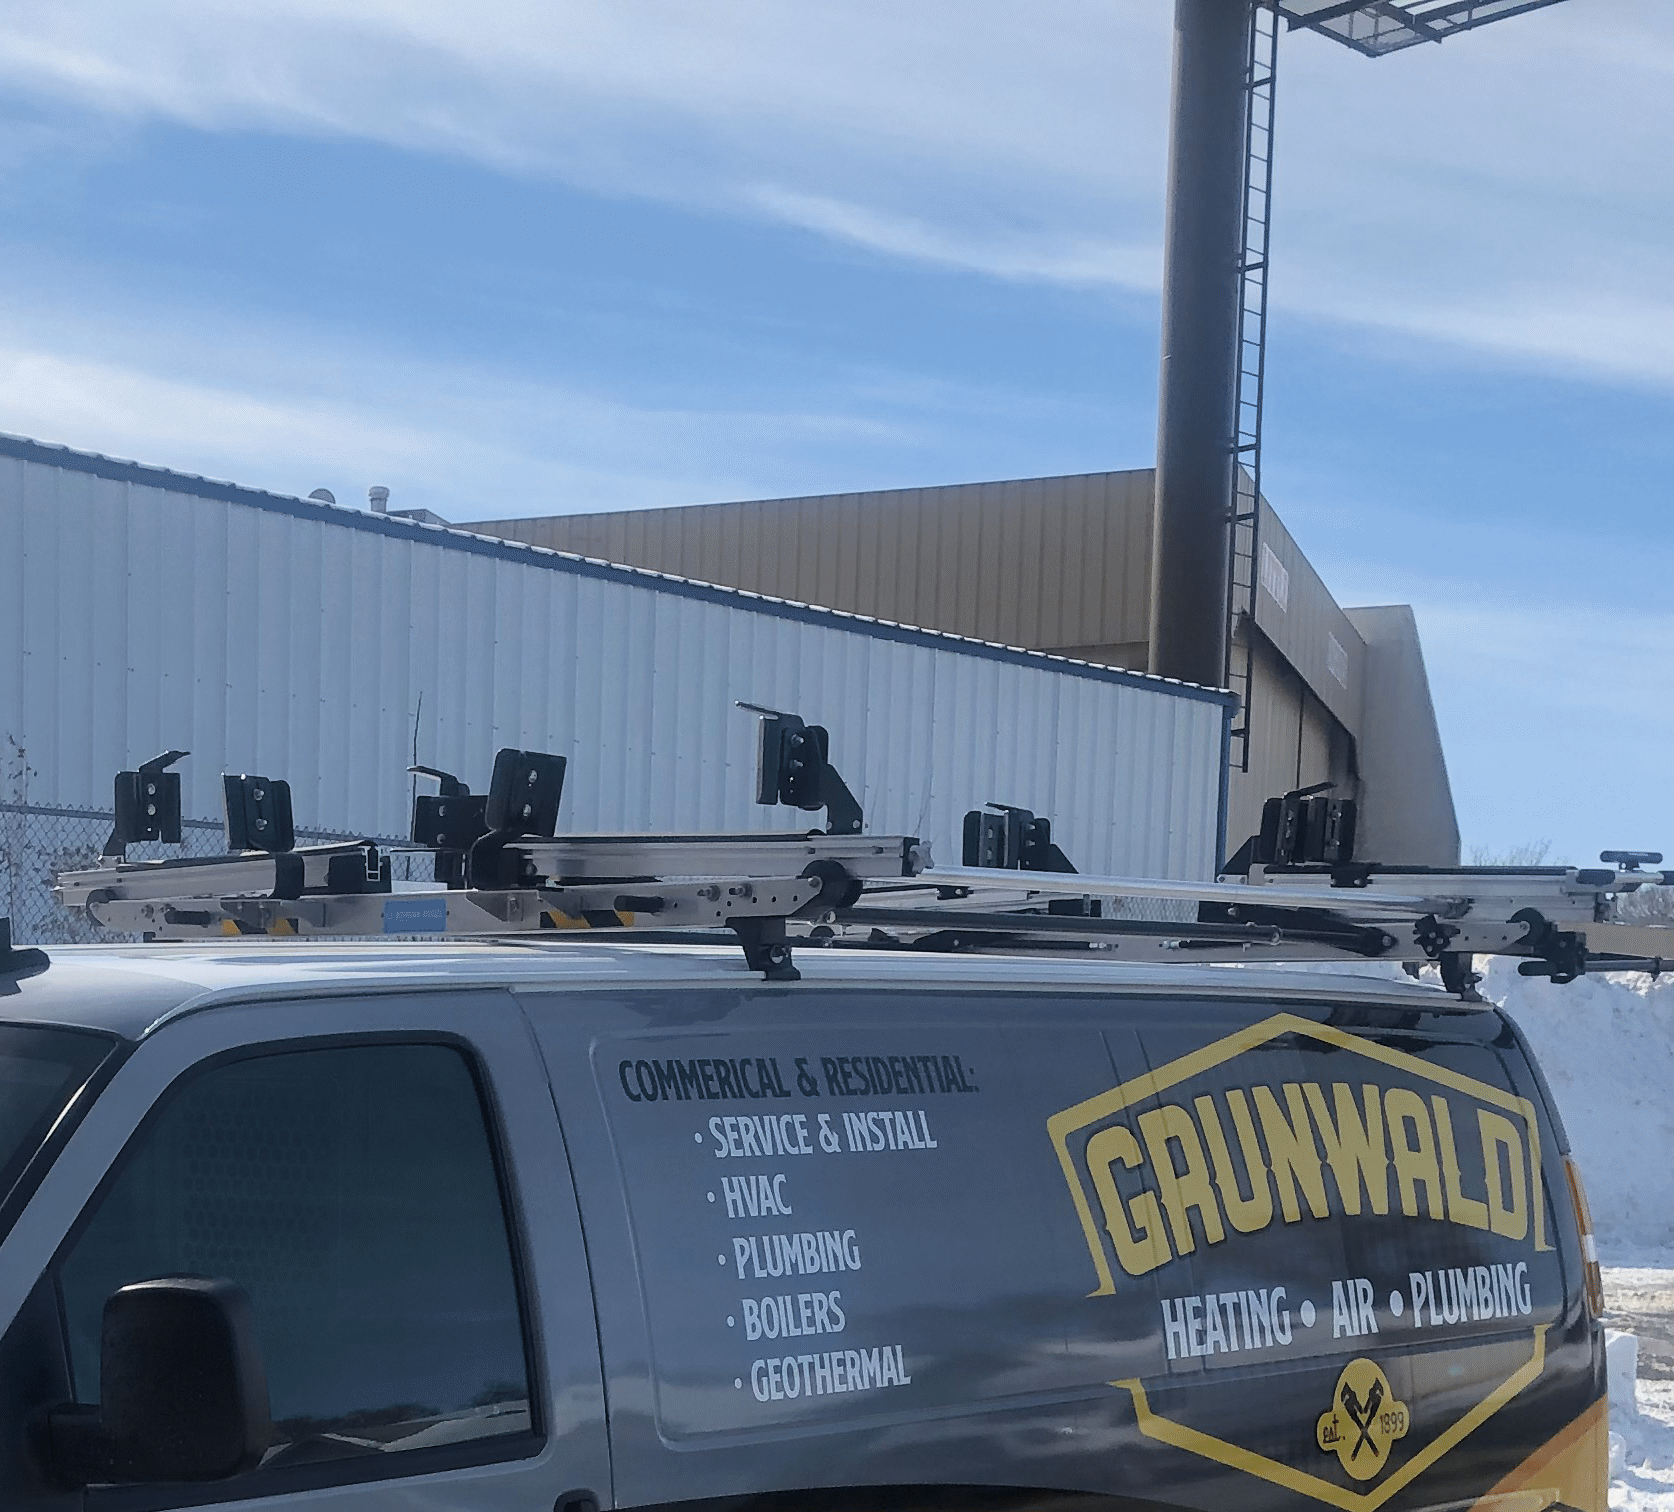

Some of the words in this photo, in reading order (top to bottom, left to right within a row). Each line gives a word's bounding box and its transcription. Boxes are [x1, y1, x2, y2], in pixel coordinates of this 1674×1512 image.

[618, 1057, 792, 1103] COMMERICAL
[796, 1056, 821, 1098] &
[820, 1054, 981, 1098] RESIDENTIAL:
[708, 1113, 814, 1158] SERVICE
[817, 1112, 842, 1154] &
[842, 1110, 938, 1151] INSTALL
[720, 1174, 792, 1219] HVAC
[1084, 1082, 1529, 1276] GRUNWALD
[732, 1229, 862, 1280] PLUMBING
[742, 1290, 846, 1341] BOILERS
[1160, 1286, 1292, 1360] HEATING
[1331, 1278, 1380, 1338] AIR
[1409, 1261, 1533, 1328] PLUMBING
[750, 1344, 912, 1402] GEOTHERMAL
[1379, 1411, 1405, 1435] 1899
